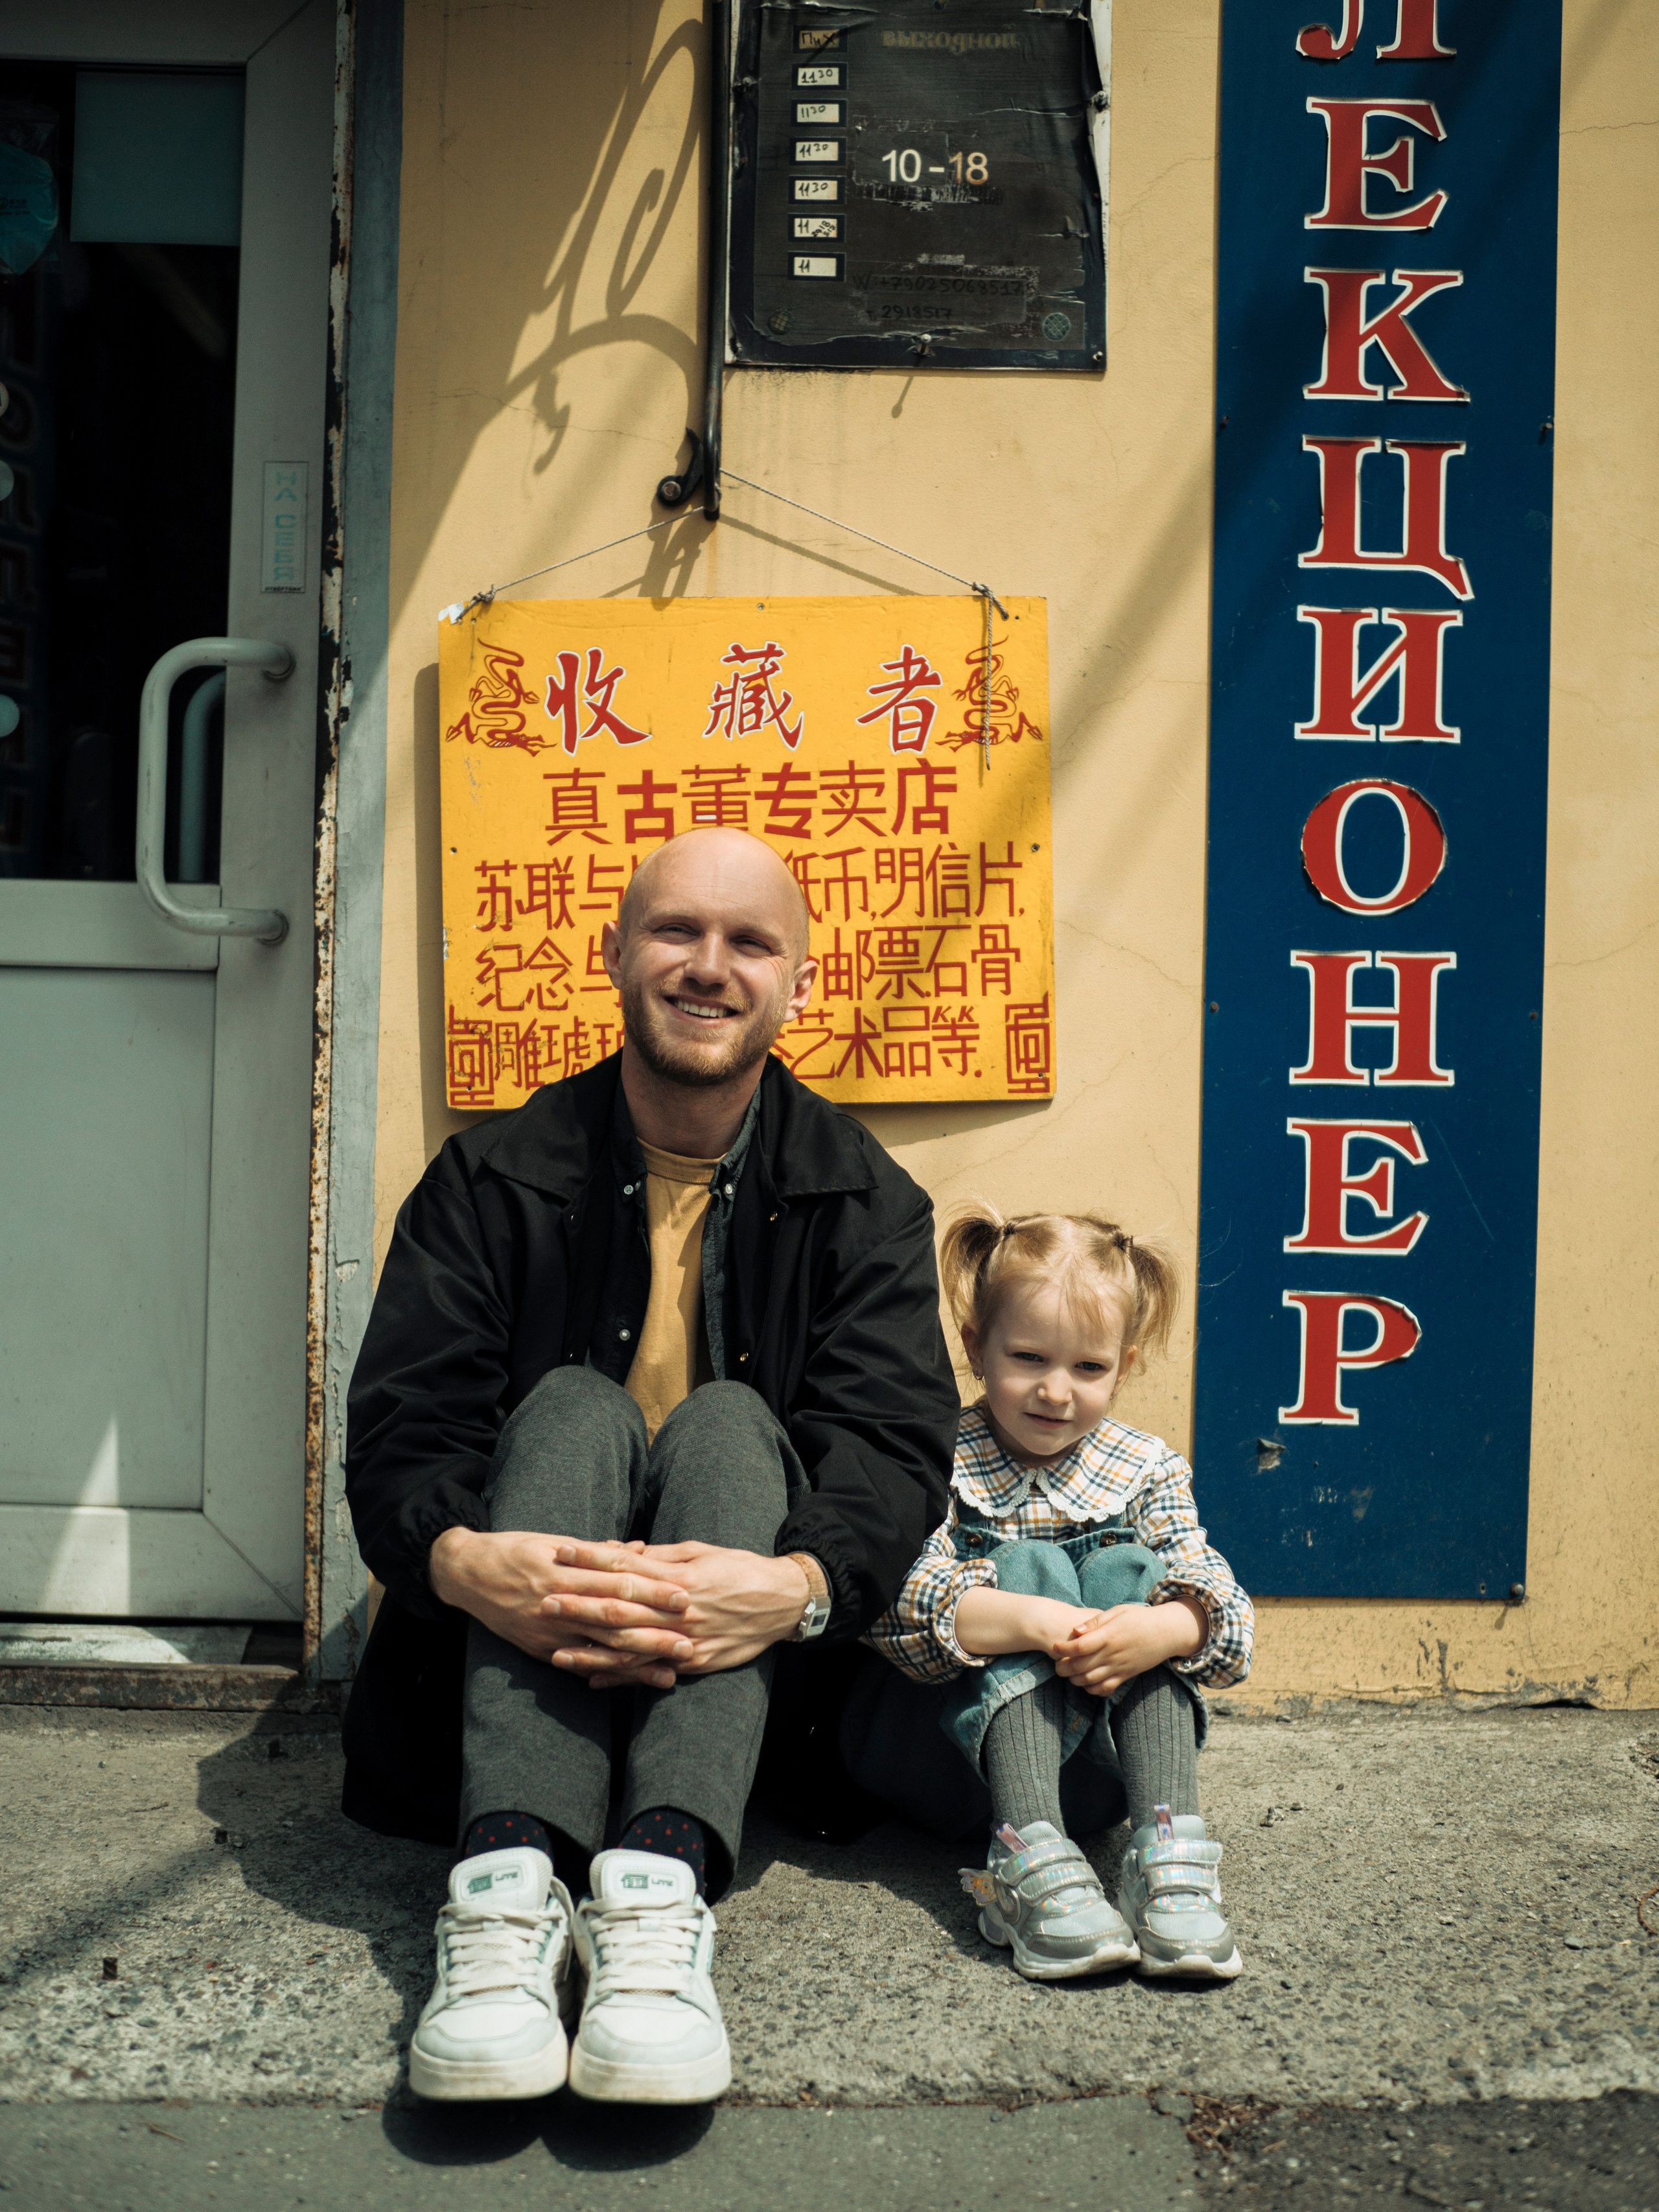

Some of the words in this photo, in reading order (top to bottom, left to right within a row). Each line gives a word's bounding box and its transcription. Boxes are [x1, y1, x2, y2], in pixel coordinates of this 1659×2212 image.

[798, 259, 810, 273] 11
[543, 640, 944, 757] 收藏者
[543, 757, 958, 846] 真古董专卖店
